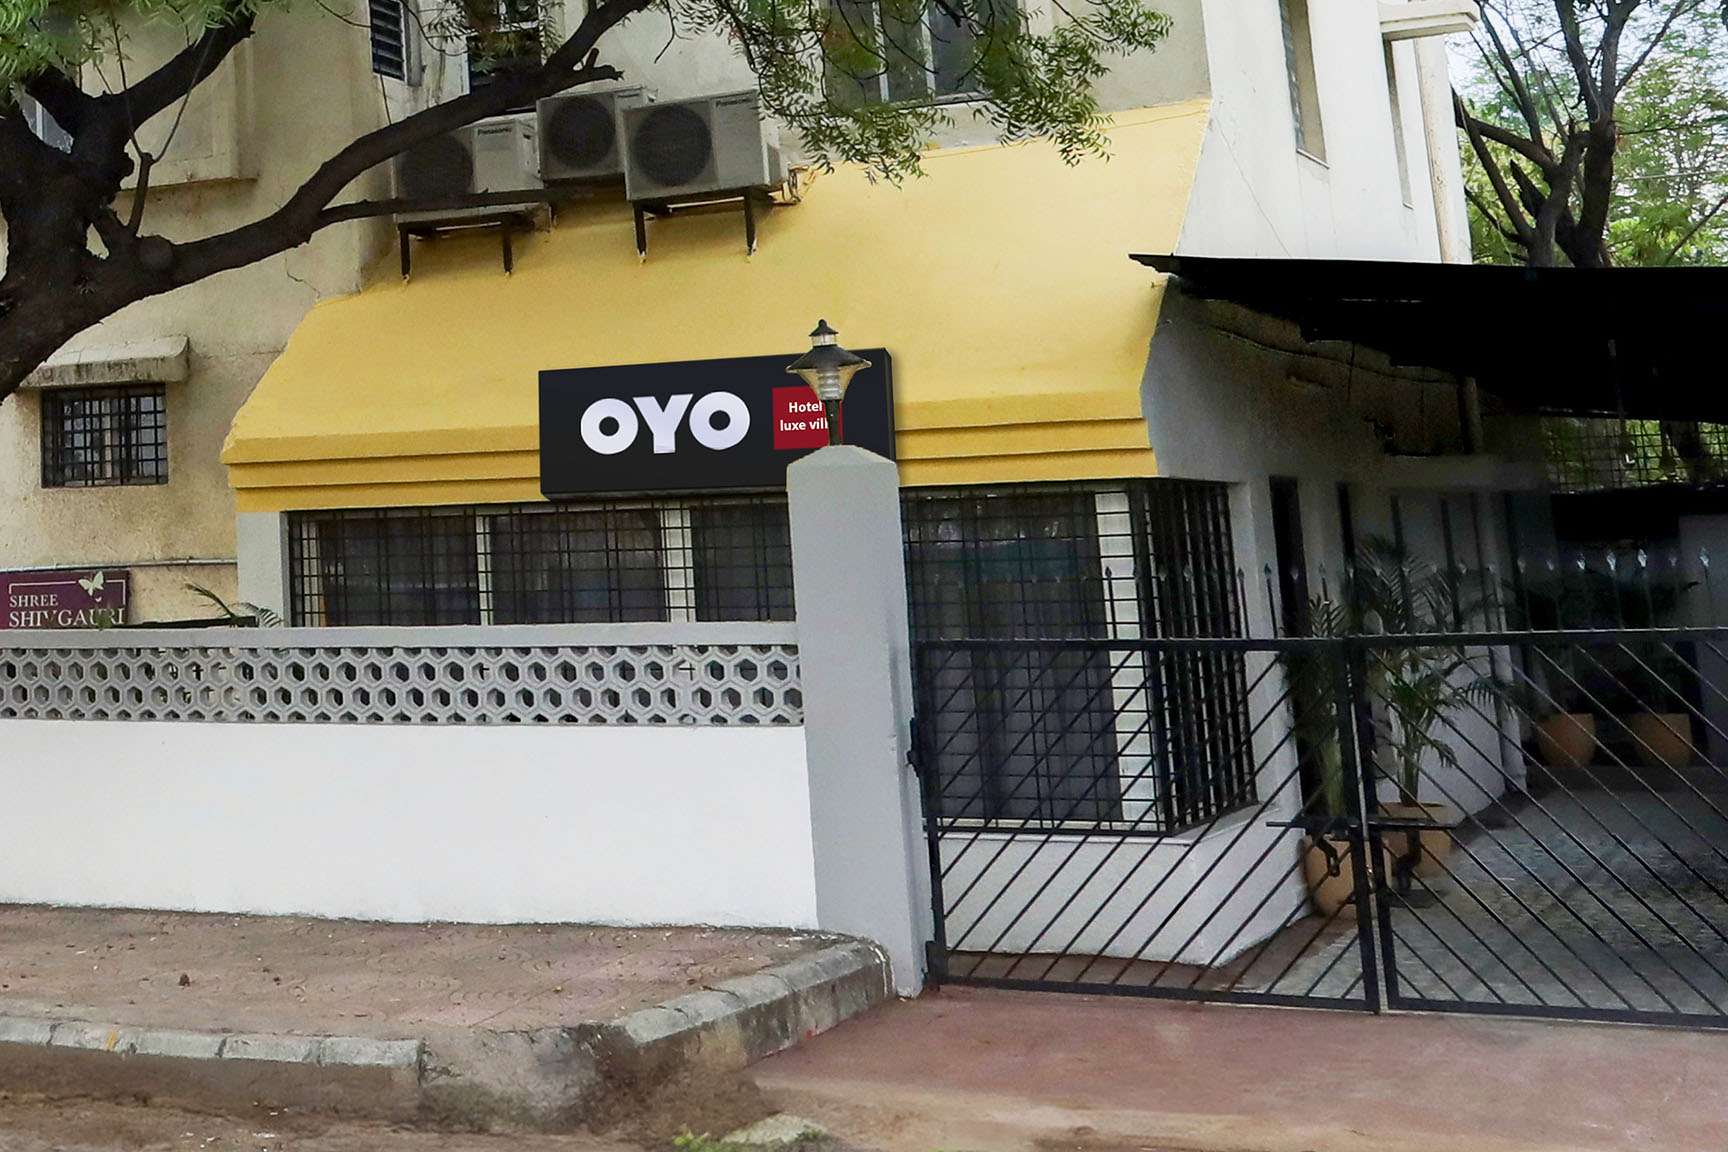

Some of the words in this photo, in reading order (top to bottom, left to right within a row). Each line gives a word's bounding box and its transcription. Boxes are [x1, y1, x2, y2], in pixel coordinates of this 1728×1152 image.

[788, 400, 823, 413] Hotel
[580, 391, 751, 455] OYO
[780, 419, 807, 432] luxe
[809, 417, 829, 430] vill
[9, 594, 59, 608] SHREE
